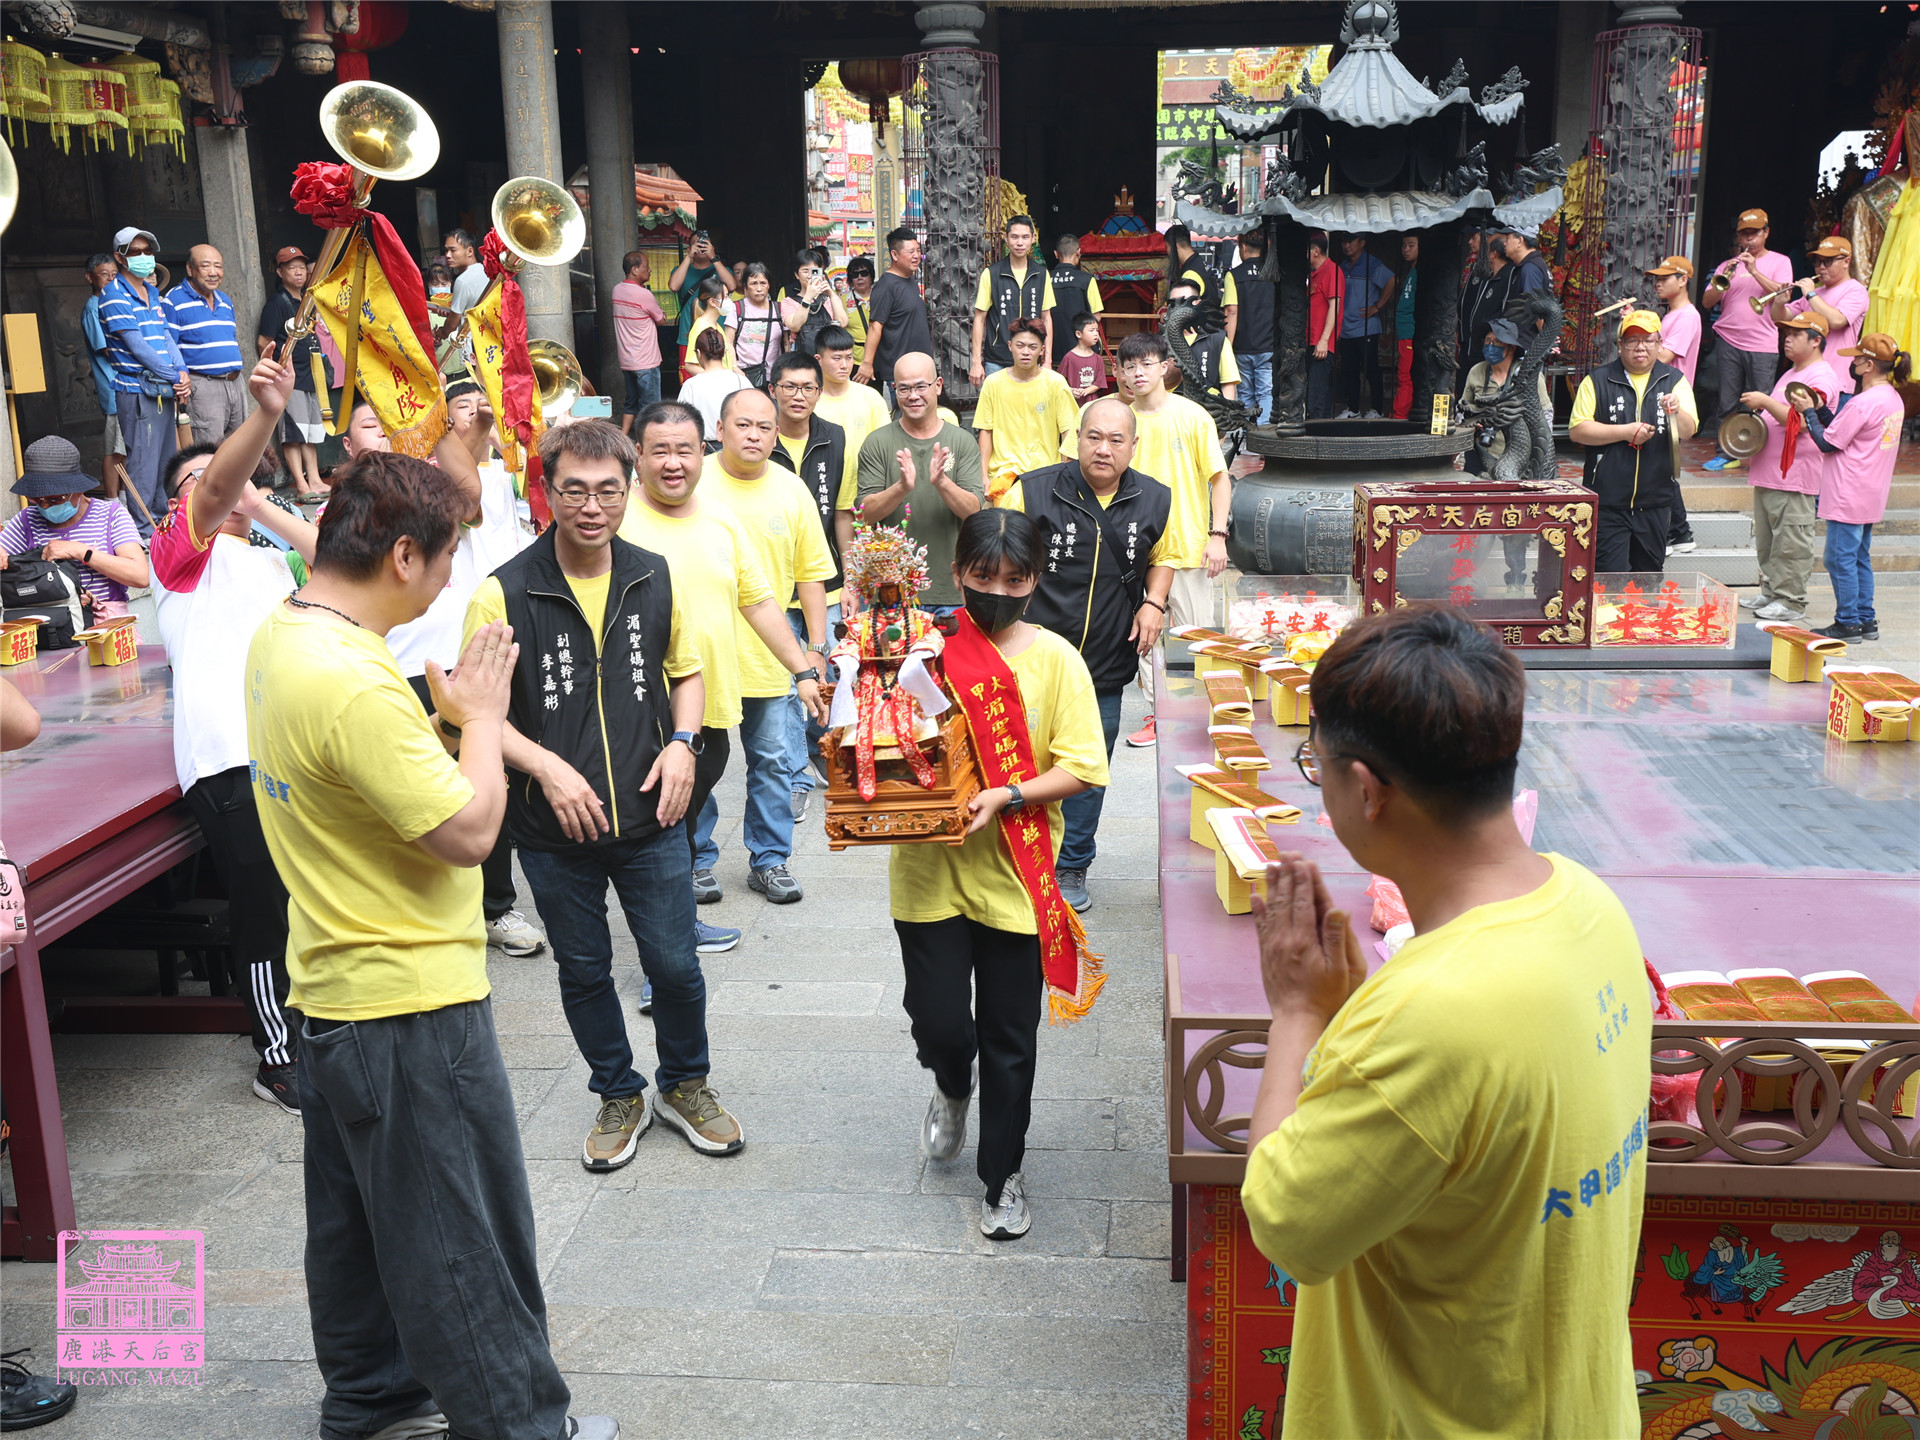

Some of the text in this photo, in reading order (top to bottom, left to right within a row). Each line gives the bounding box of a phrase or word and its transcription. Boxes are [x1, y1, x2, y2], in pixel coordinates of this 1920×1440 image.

[817, 461, 830, 515] 湄聖媽祖會
[1048, 533, 1063, 573] 陳建生
[1064, 522, 1078, 558] 總務長
[1126, 521, 1138, 565] 湄聖媽
[1260, 610, 1332, 635] 平安米
[1611, 602, 1722, 639] 平安米
[11, 631, 29, 662] 福
[114, 628, 131, 662] 福
[556, 633, 575, 695] 副總幹事
[626, 613, 648, 702] 湄聖媽祖會
[541, 653, 559, 711] 李嘉彬
[1828, 688, 1845, 736] 福
[1540, 1103, 1648, 1224] 大甲湄聖媽
